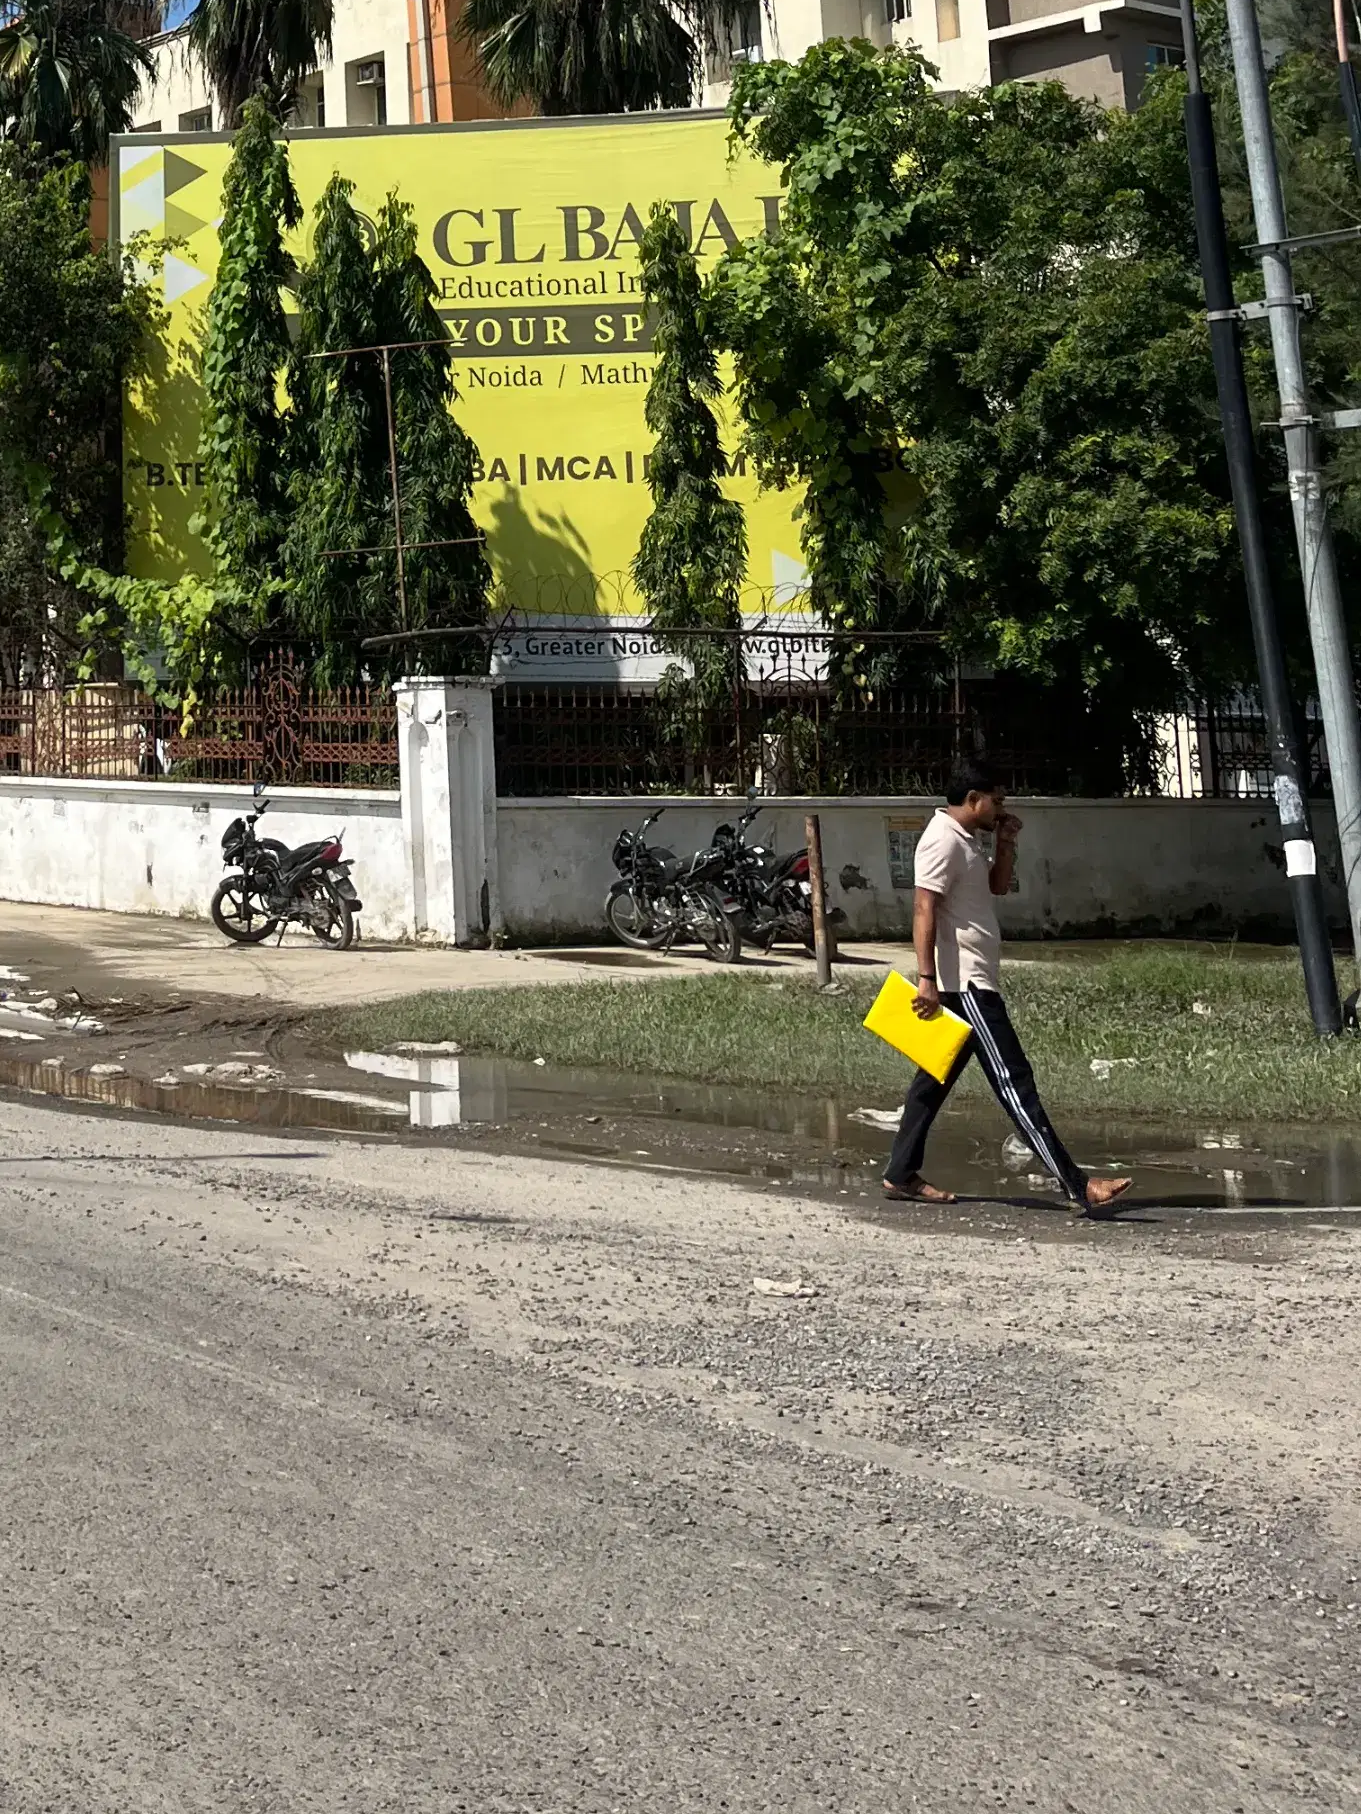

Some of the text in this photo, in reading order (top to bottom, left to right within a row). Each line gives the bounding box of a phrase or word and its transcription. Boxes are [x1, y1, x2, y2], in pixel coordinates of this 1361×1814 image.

[433, 208, 546, 267] GL
[439, 271, 608, 299] Educational
[443, 316, 571, 347] YOUR
[468, 365, 543, 388] Noida
[536, 455, 617, 481] MCA
[526, 637, 605, 656] Greater
